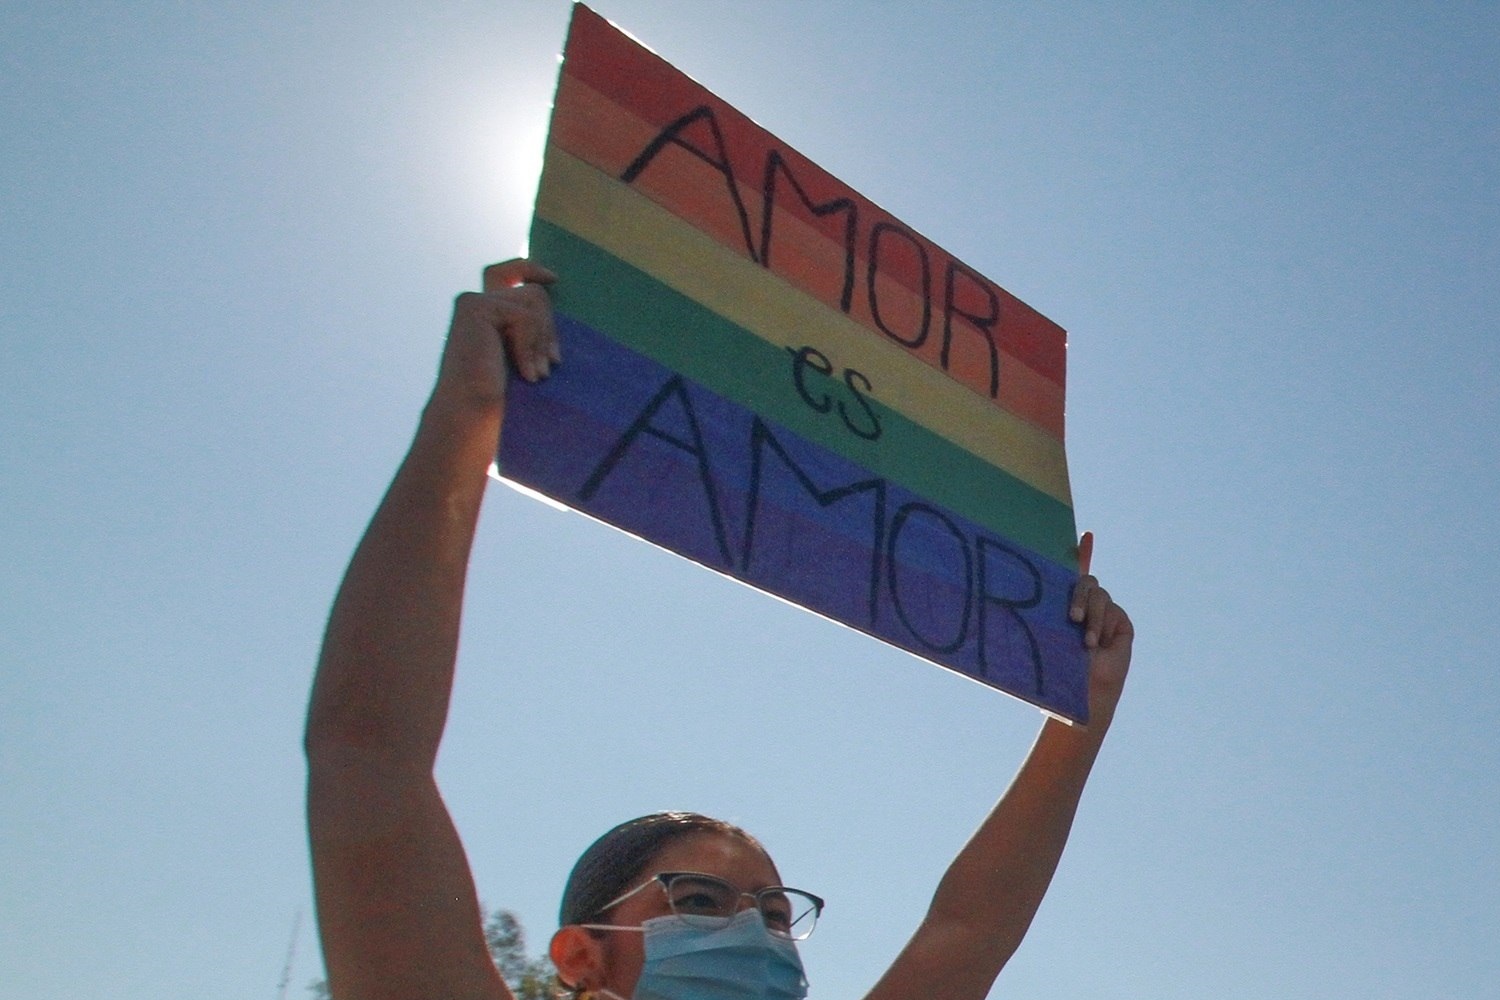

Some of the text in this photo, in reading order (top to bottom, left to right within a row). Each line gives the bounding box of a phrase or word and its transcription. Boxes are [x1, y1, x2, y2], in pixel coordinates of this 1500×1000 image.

[620, 105, 999, 399] AMOR
[785, 345, 882, 441] es
[576, 374, 1045, 697] AMOR
